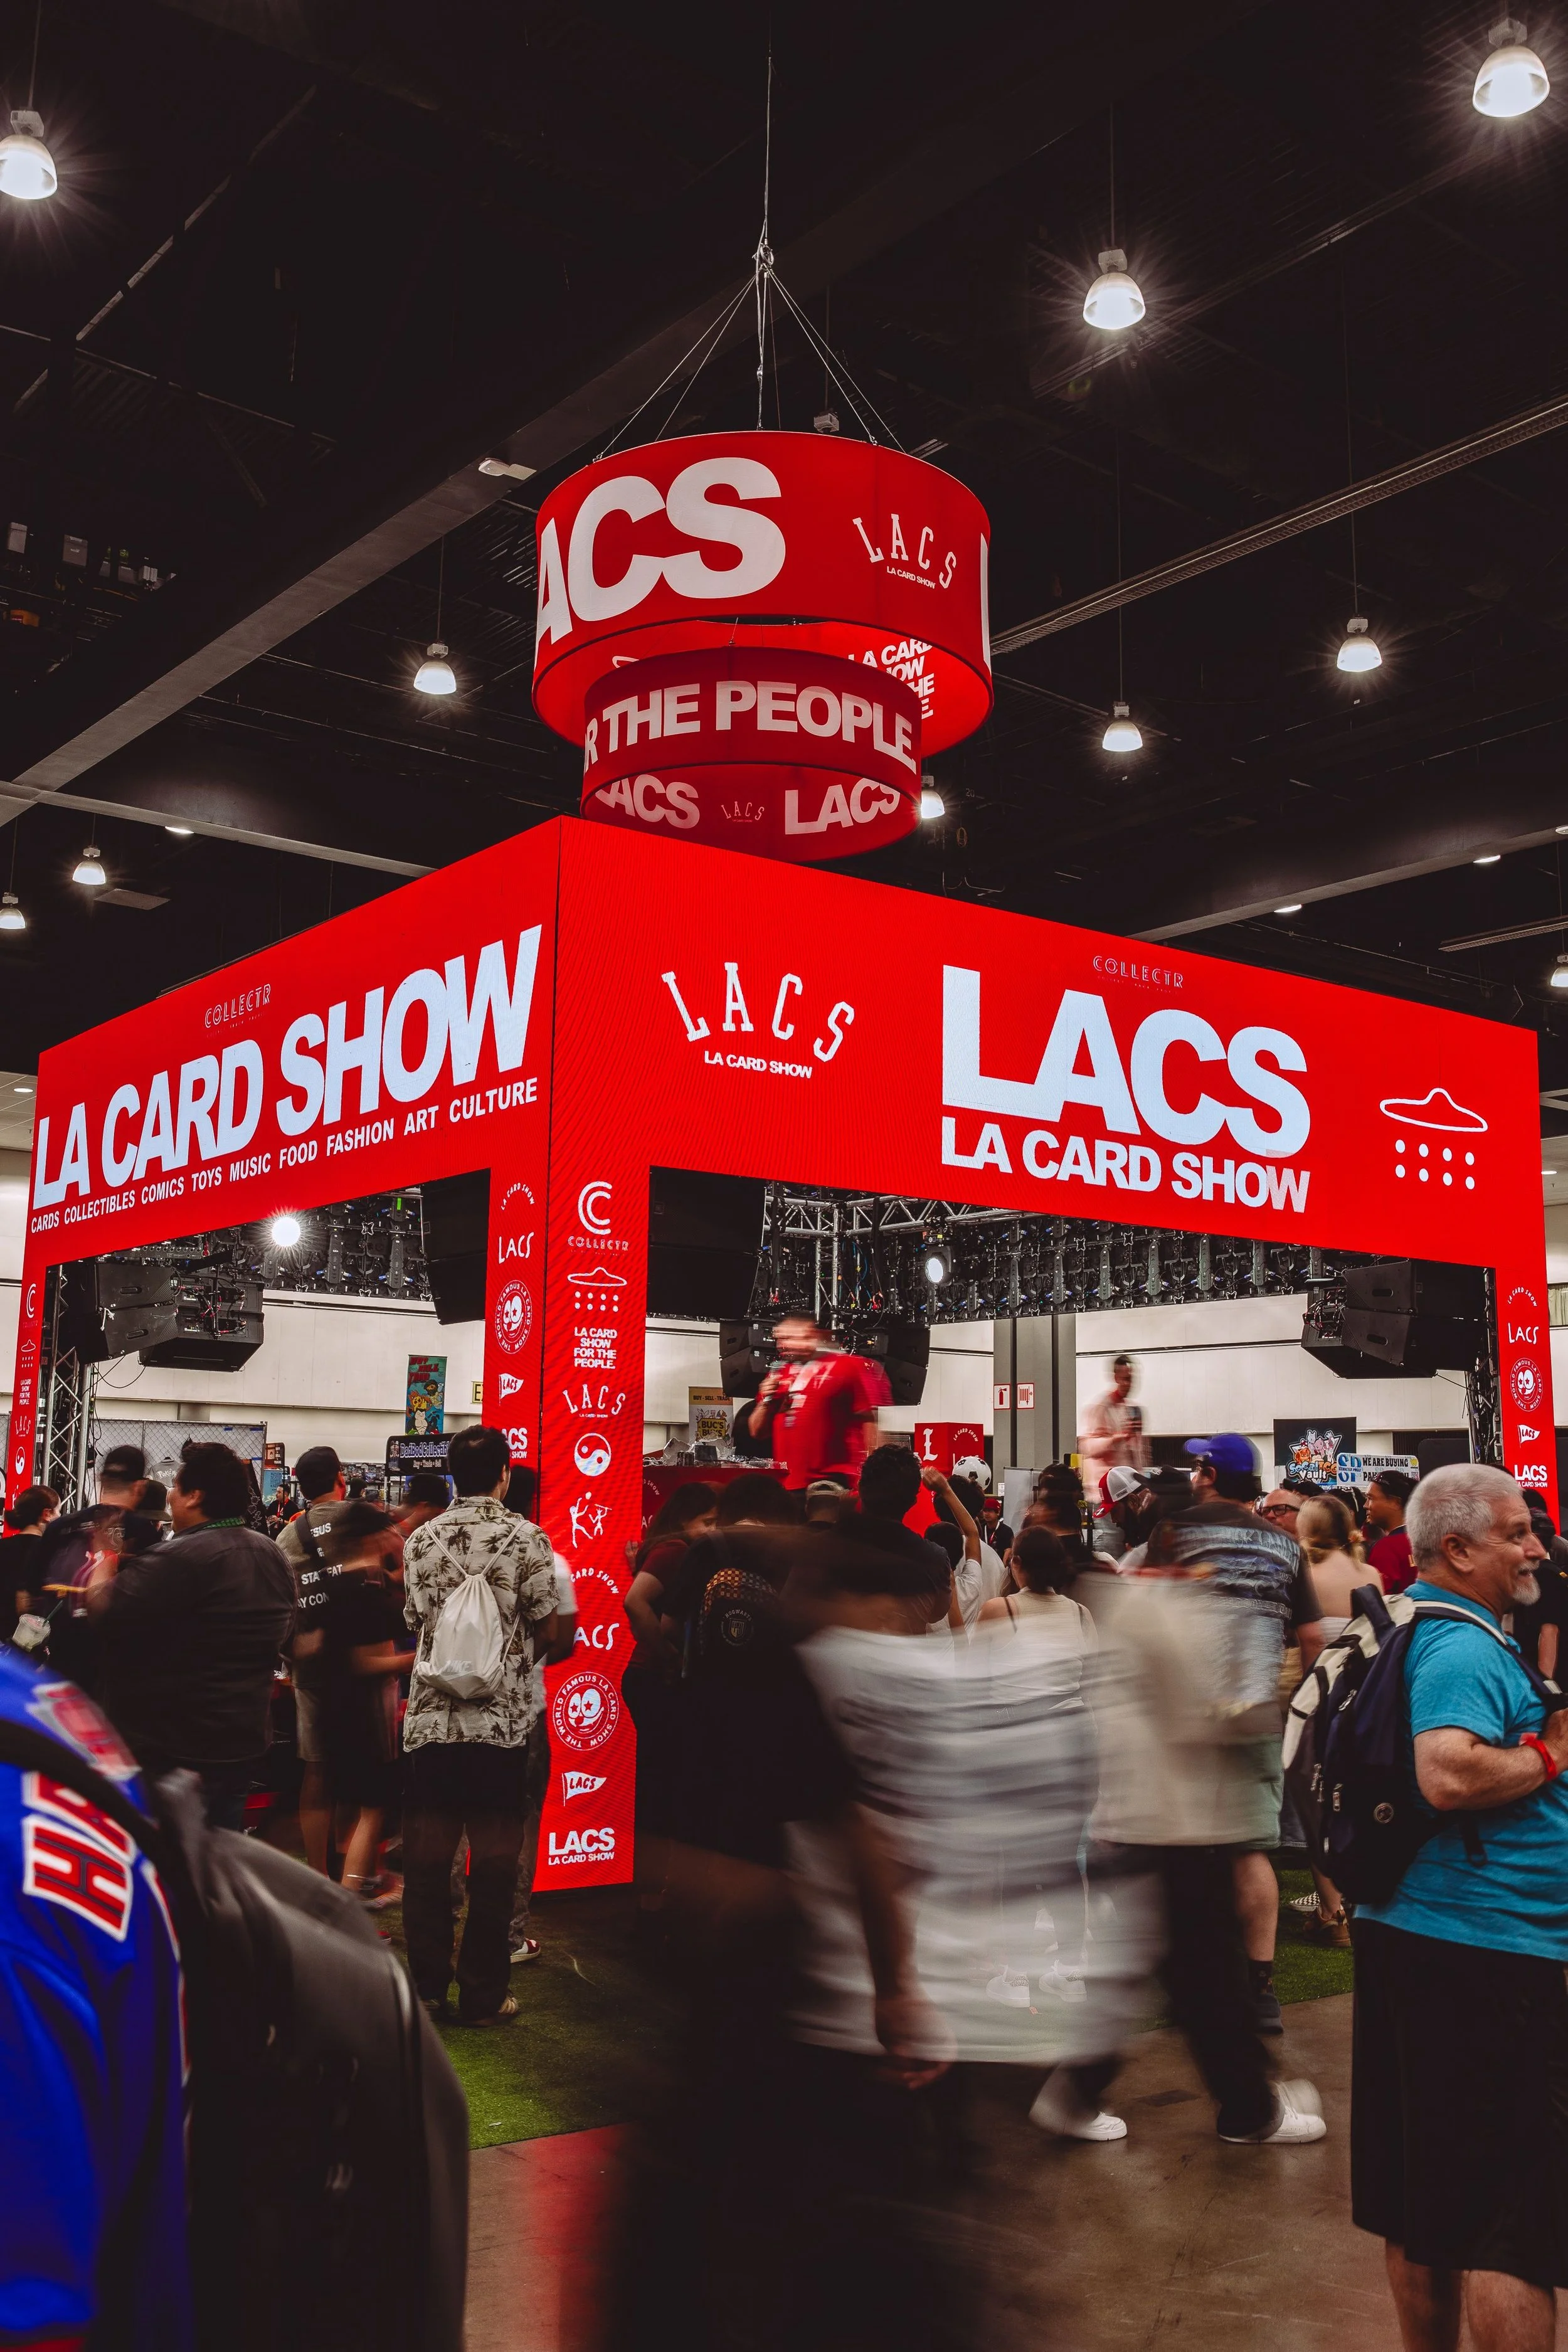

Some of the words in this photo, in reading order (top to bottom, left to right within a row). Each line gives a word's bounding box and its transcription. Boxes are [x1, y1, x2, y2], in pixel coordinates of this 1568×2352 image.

[852, 514, 956, 589] LACS
[533, 457, 785, 671] ACS
[887, 566, 896, 575] LA
[897, 569, 916, 581] CARD
[916, 576, 935, 589] SHOW
[886, 655, 924, 681] OW
[906, 673, 934, 698] HE
[603, 684, 700, 753] THE
[721, 802, 765, 820] LACS
[1093, 955, 1183, 988] COLLECTR
[205, 983, 271, 1028] COLLECTR
[662, 962, 854, 1062] LACS
[33, 1103, 90, 1209] LA
[102, 1040, 263, 1187] CARD
[277, 924, 542, 1136] SHOW
[705, 1051, 724, 1065] LA
[726, 1054, 766, 1071] CARD
[770, 1061, 812, 1078] SHOW
[943, 965, 1310, 1158] LACS
[31, 1213, 59, 1234] CARDS
[65, 1190, 135, 1225] COLLECTIBLES
[142, 1177, 184, 1204] COMICS
[192, 1167, 221, 1191] TOYS
[230, 1153, 270, 1182] MUSIC
[280, 1141, 317, 1168] FOOD
[327, 1118, 394, 1156] FASHION
[404, 1106, 438, 1135] ART
[450, 1078, 537, 1123] CULTURE
[942, 1116, 1012, 1173] LA
[1022, 1130, 1162, 1192] CARD
[1172, 1152, 1310, 1213] SHOW
[501, 1199, 507, 1210] LA
[507, 1182, 521, 1198] CARD
[522, 1184, 534, 1204] SHOW
[499, 1232, 534, 1264] LACS
[568, 1236, 628, 1251] COLLECTR
[501, 1283, 520, 1302] FAMOUS
[521, 1287, 527, 1297] LA
[1508, 1295, 1512, 1304] LA
[1512, 1287, 1524, 1296] CARD
[1525, 1290, 1537, 1306] SHOW
[514, 1329, 528, 1350] SHOW
[575, 1327, 588, 1337] LA
[590, 1328, 617, 1338] CARD
[580, 1338, 612, 1348] SHOW
[1508, 1322, 1539, 1344] LACS
[501, 1339, 511, 1351] THE
[574, 1348, 595, 1358] FOR
[596, 1349, 617, 1359] THE
[1513, 1360, 1530, 1372] FAMOUS
[502, 1378, 518, 1391] LACS
[563, 1384, 626, 1416] LACS
[1518, 1400, 1526, 1409] THE
[1530, 1395, 1540, 1409] SHOW
[968, 1430, 978, 1442] SHOW
[1522, 1429, 1535, 1439] LACS
[1362, 1458, 1372, 1466] WE
[1372, 1458, 1385, 1466] ARE
[1385, 1458, 1409, 1467] BUYING
[1514, 1465, 1547, 1481] LACS
[1300, 1470, 1327, 1479] Vault
[648, 1480, 660, 1495] SHOW
[596, 1571, 619, 1594] SHOW
[573, 1623, 620, 1650] ACS
[562, 1675, 596, 1695] FAMOUS
[599, 1680, 608, 1692] LA
[555, 1697, 566, 1735] WORLD
[608, 1692, 617, 1720] CARD
[565, 1735, 582, 1747] THE
[590, 1724, 612, 1747] SHOW
[569, 1776, 596, 1789] LACS
[549, 1828, 615, 1856] LACS
[548, 1857, 560, 1866] LA
[561, 1855, 586, 1864] CARD
[588, 1851, 615, 1862] SHOW
